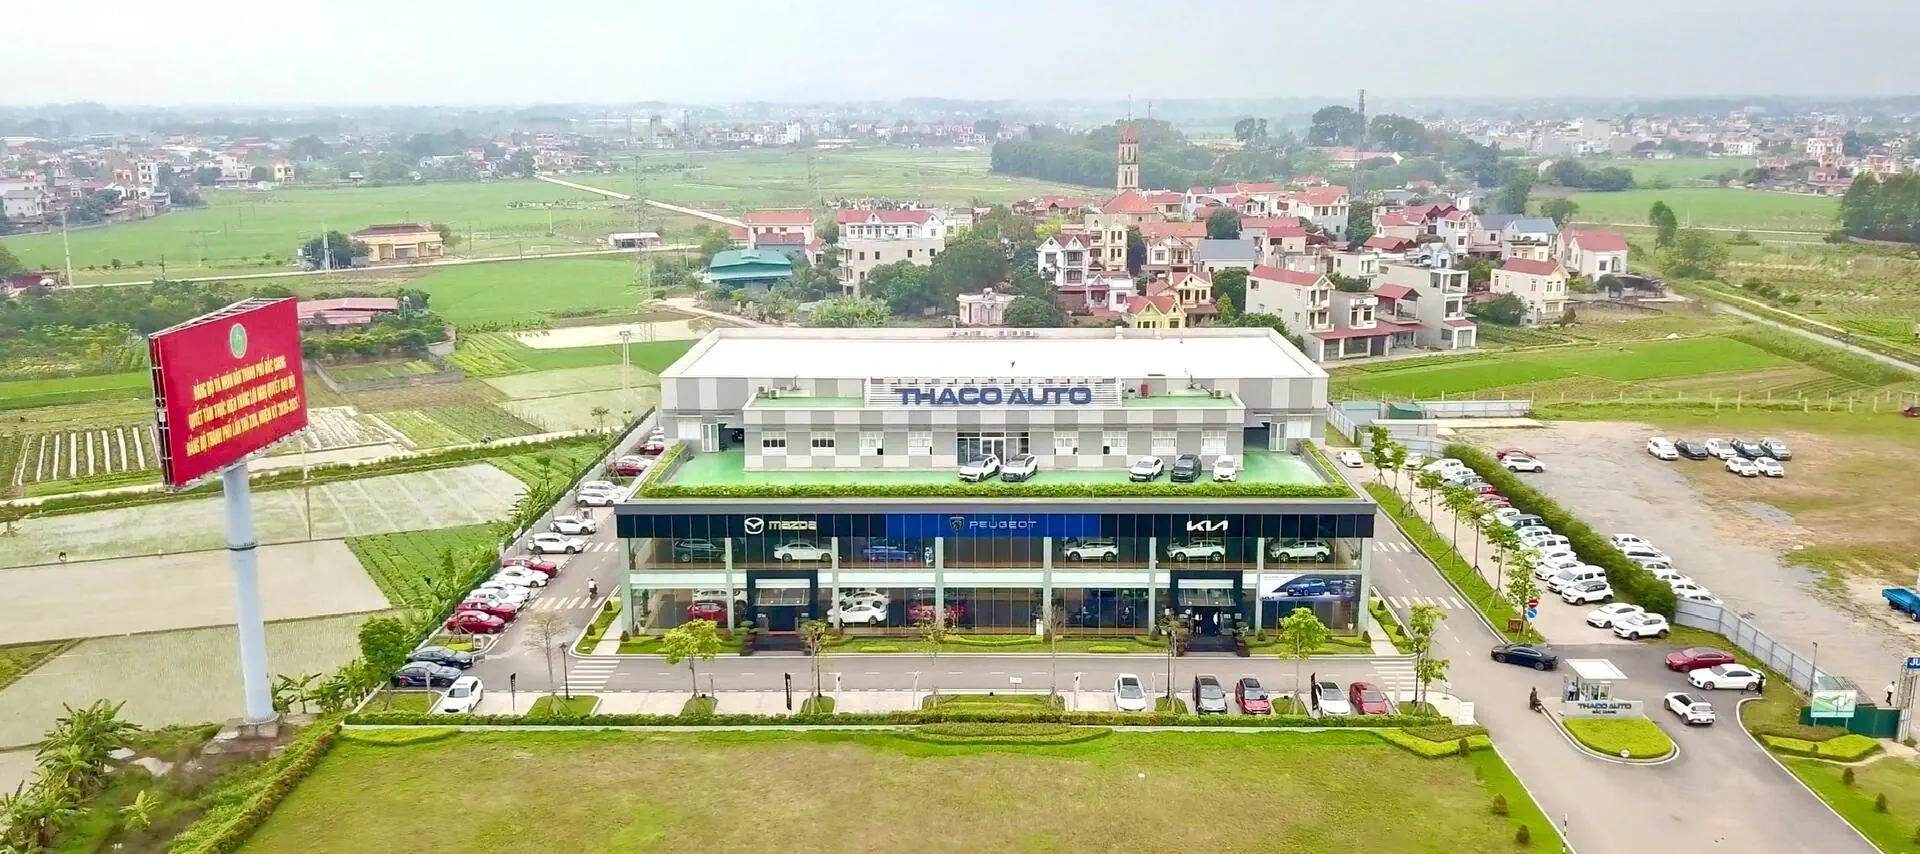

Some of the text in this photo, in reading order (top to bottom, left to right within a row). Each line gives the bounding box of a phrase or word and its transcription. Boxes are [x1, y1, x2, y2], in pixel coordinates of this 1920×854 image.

[255, 357, 264, 377] PHỐ
[895, 387, 1091, 405] THACO AUTO
[969, 520, 1037, 528] PEUGEOT
[1187, 520, 1229, 531] KIA
